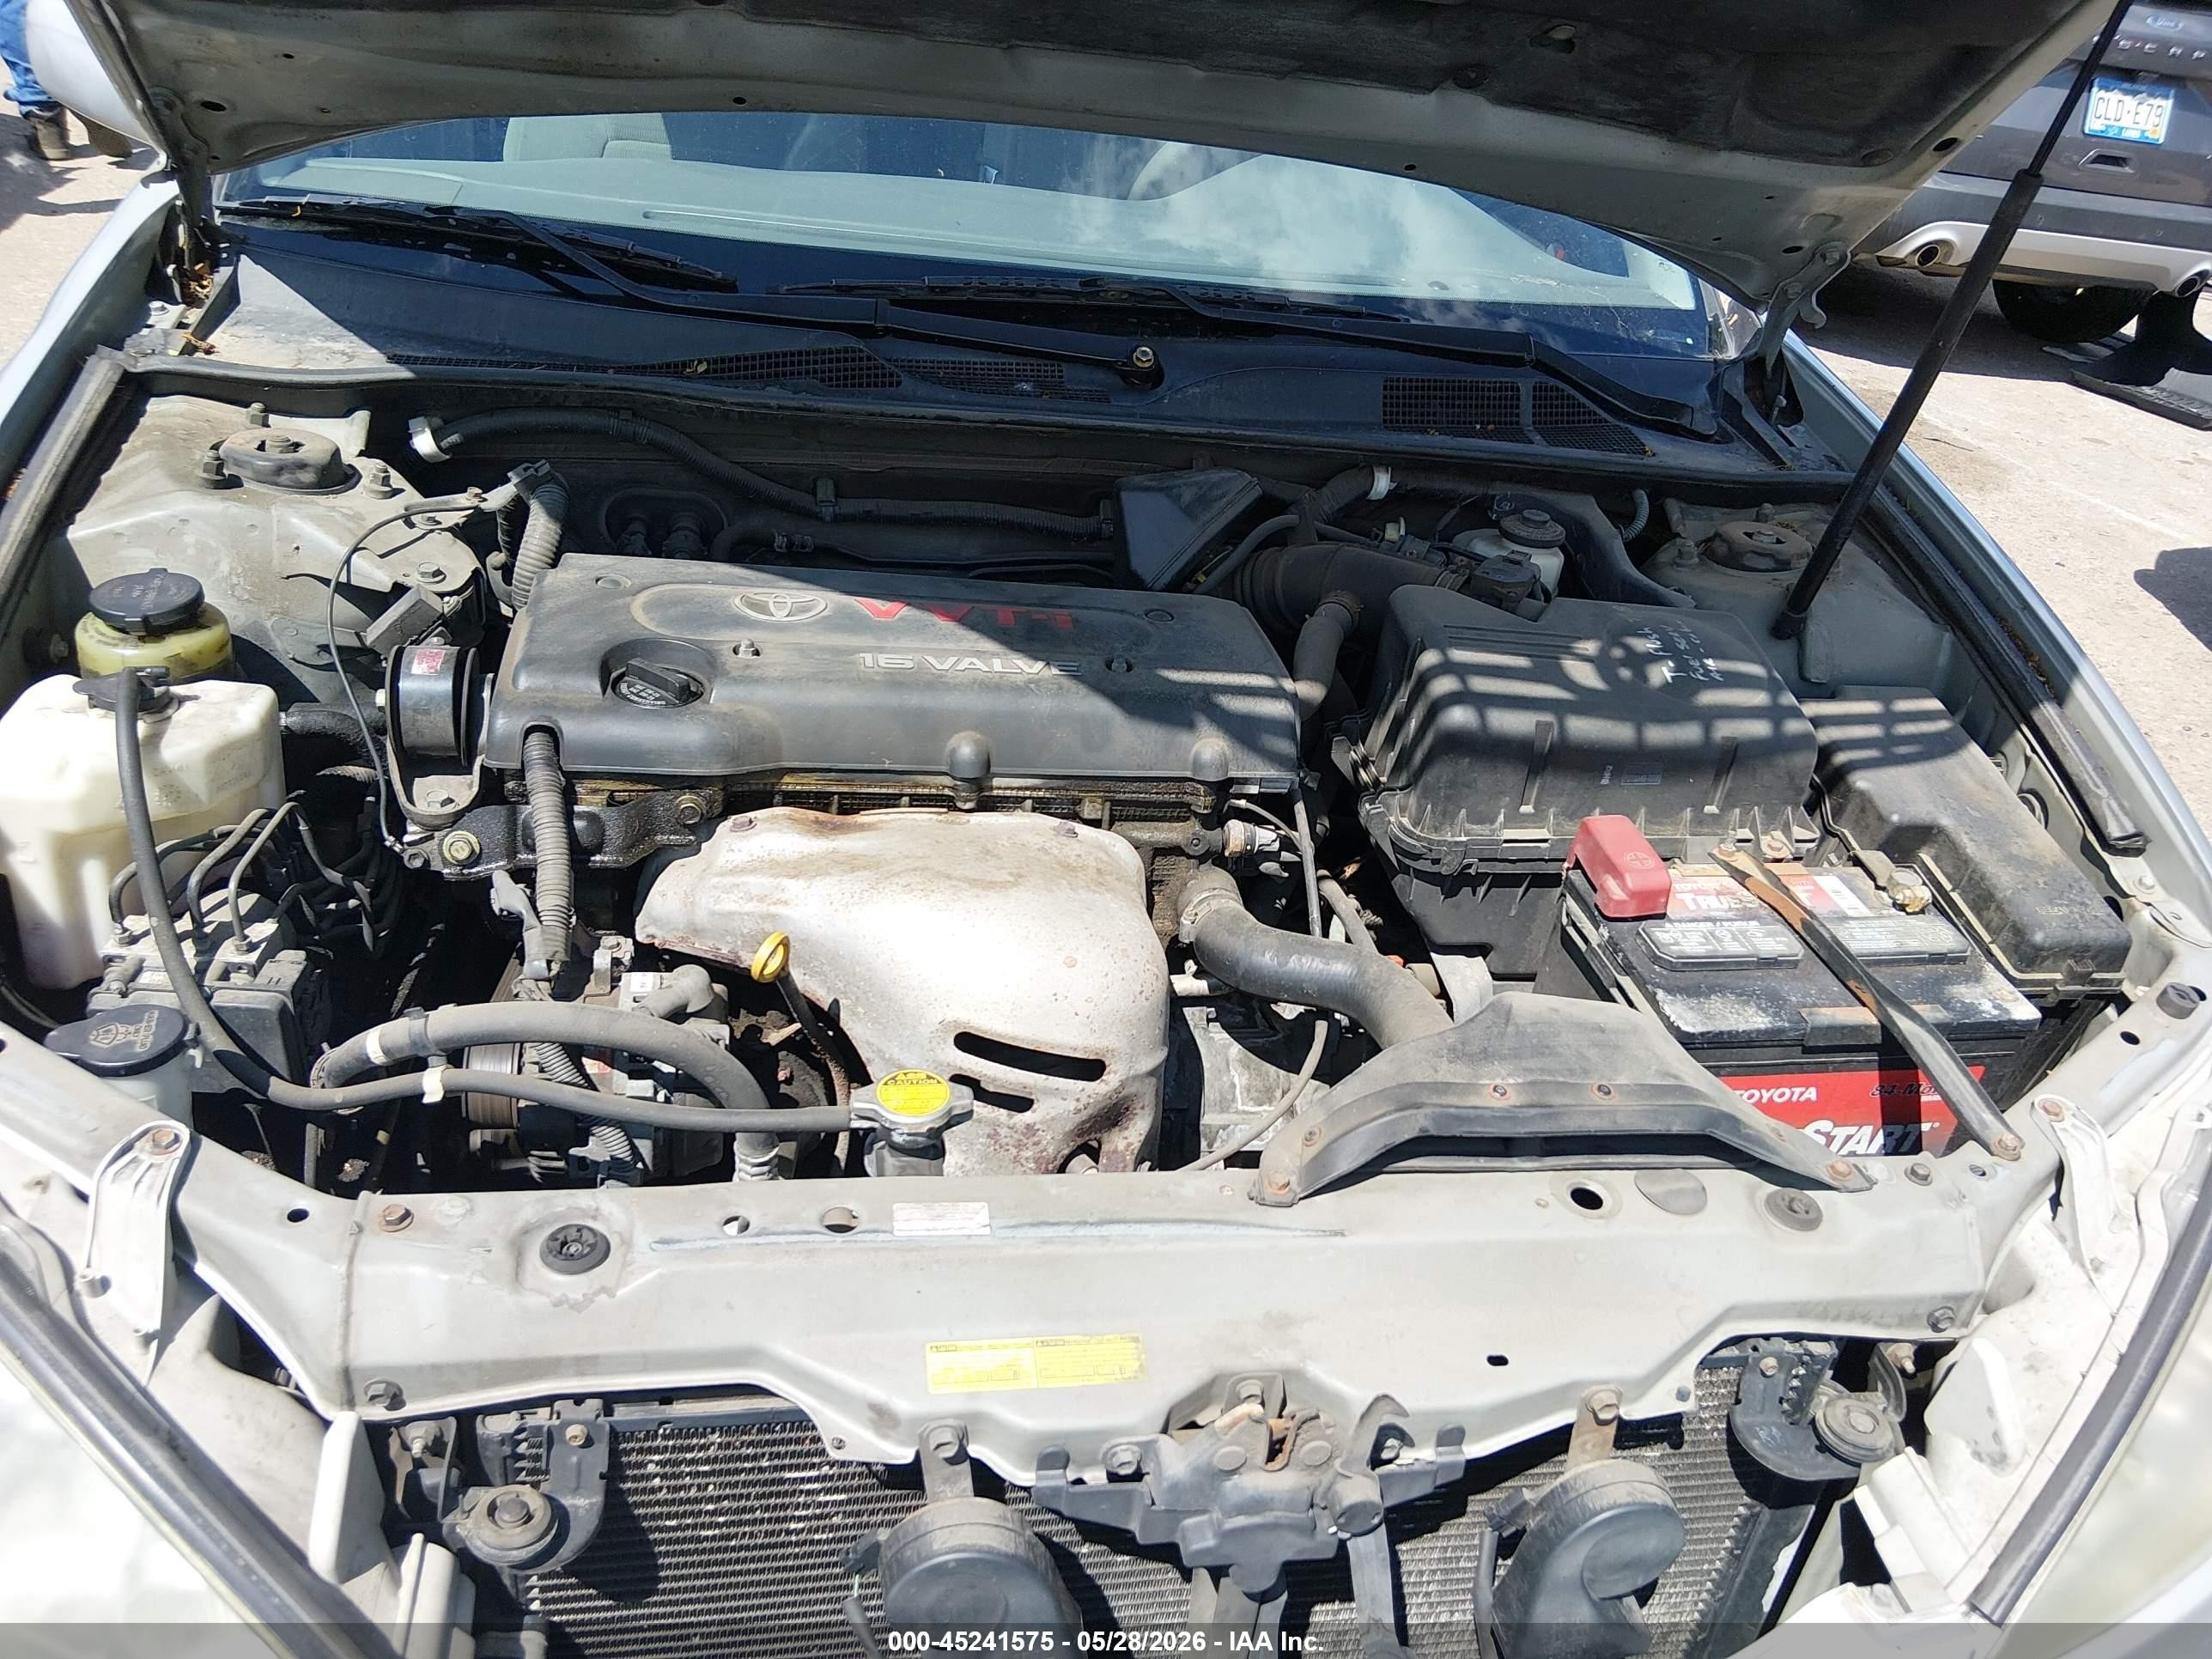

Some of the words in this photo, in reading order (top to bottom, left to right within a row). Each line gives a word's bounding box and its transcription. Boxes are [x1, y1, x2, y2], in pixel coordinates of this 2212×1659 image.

[859, 653, 915, 670] 16
[921, 655, 1083, 676] VALVE
[1869, 1082, 1938, 1097] 84-Mo
